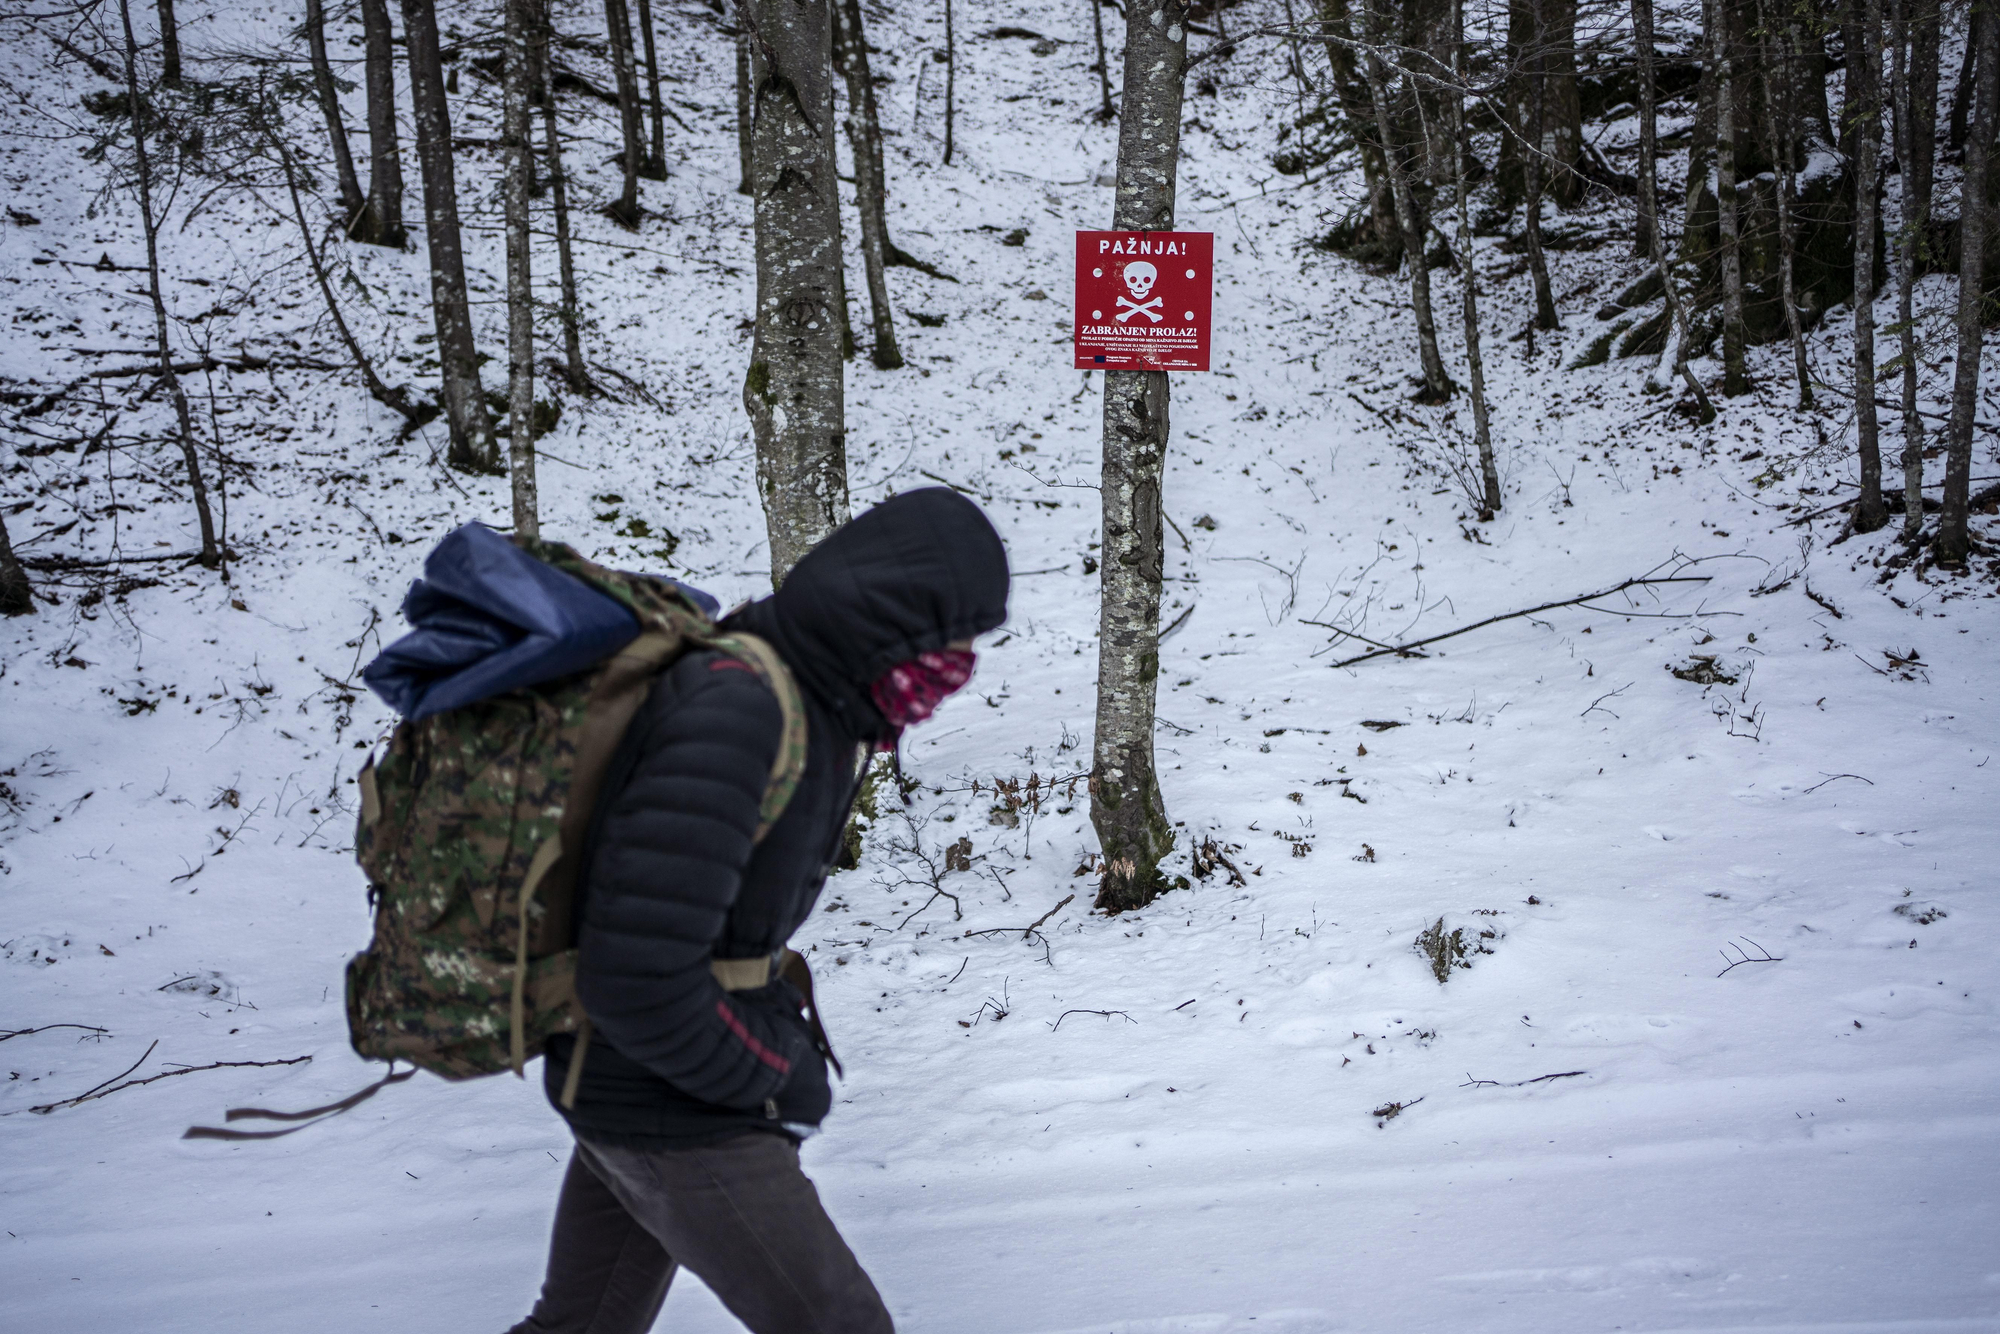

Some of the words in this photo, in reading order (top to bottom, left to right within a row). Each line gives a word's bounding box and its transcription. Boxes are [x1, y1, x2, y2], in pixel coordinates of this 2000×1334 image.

[1099, 237, 1187, 256] PAŽNJA!
[1082, 325, 1147, 336] ZABRANJEN
[1150, 327, 1197, 336] PROLAZ!
